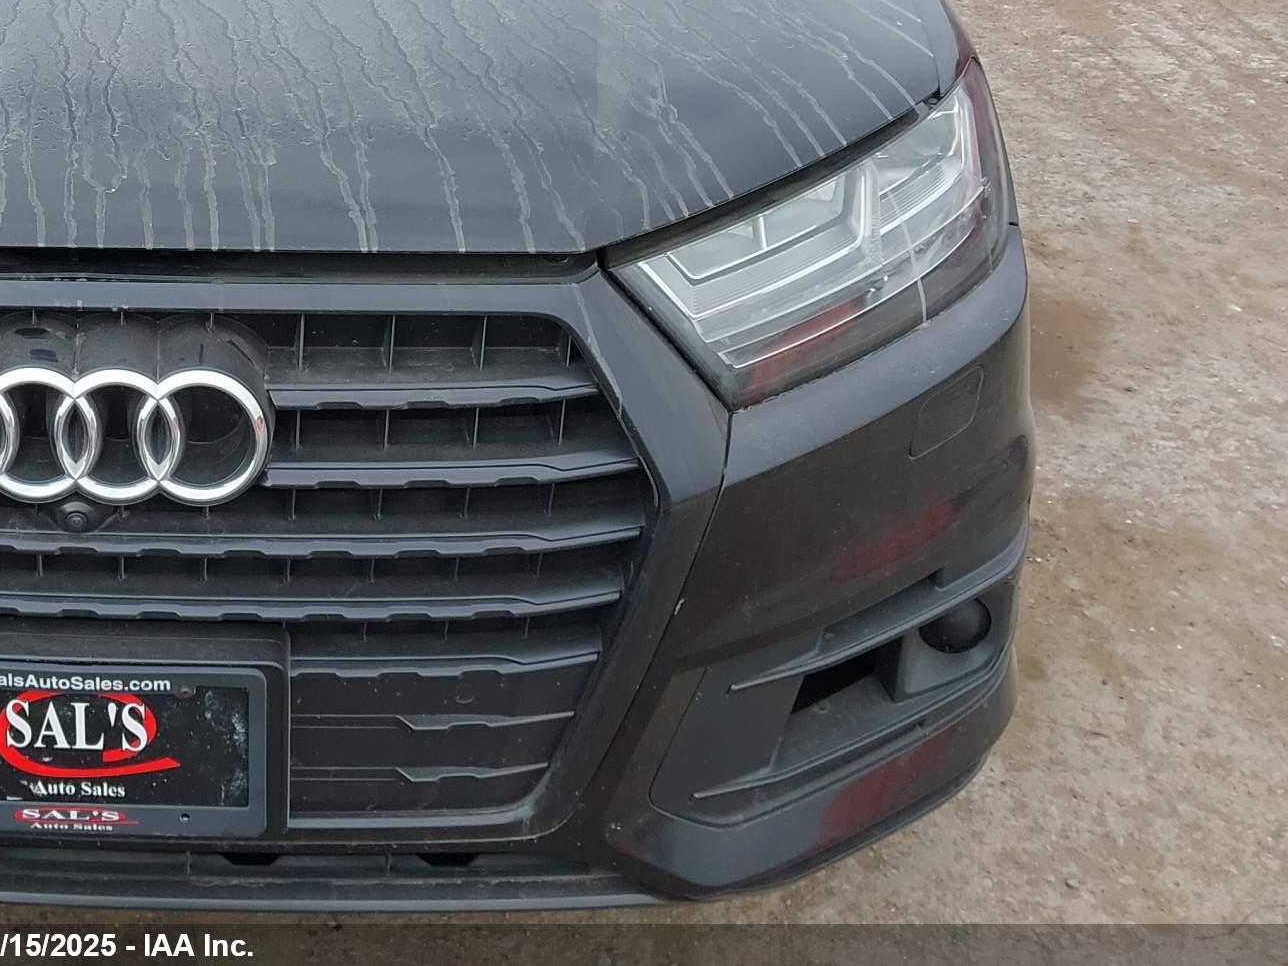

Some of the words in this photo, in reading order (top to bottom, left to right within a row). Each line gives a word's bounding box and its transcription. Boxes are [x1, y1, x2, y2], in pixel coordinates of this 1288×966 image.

[5, 699, 148, 752] SAL'S
[30, 780, 75, 796] Auto
[81, 781, 125, 797] Sales
[22, 808, 120, 821] SAL'S
[30, 822, 69, 830] Auto
[73, 822, 113, 831] Sales
